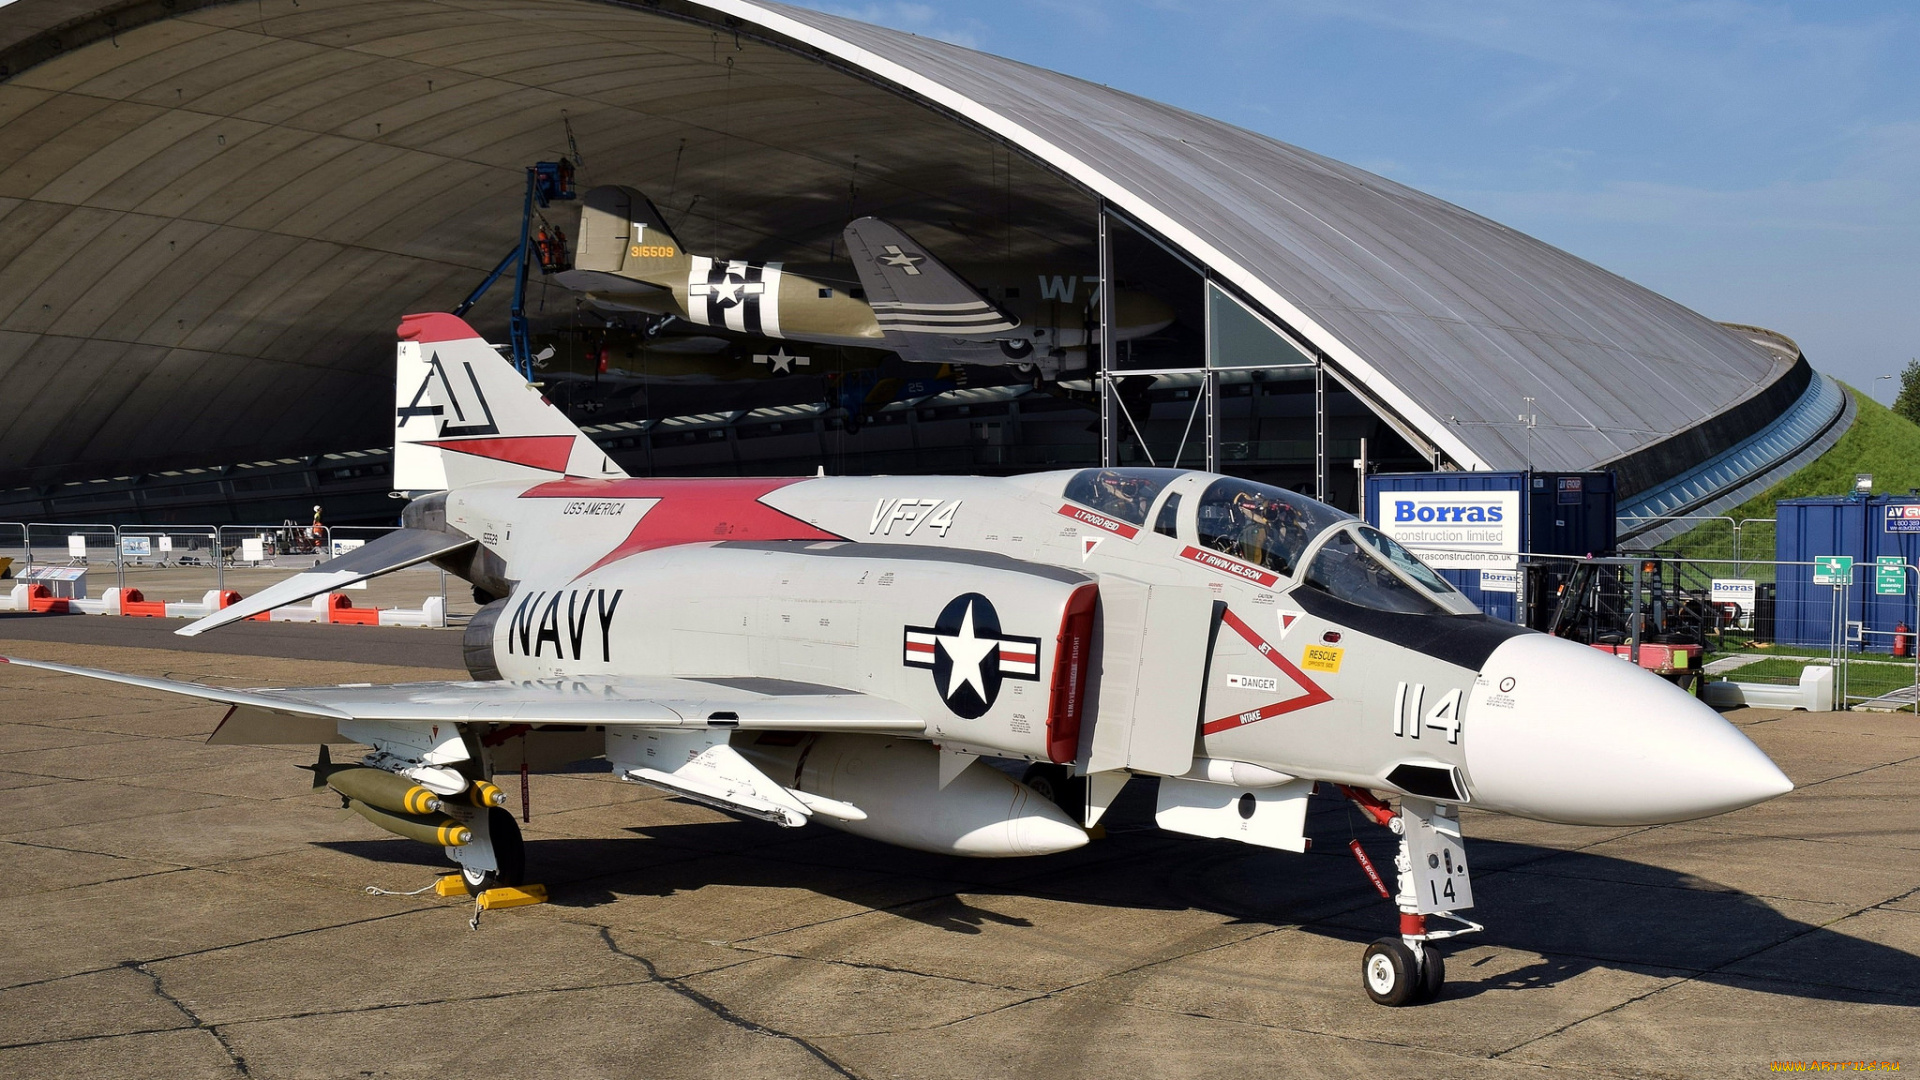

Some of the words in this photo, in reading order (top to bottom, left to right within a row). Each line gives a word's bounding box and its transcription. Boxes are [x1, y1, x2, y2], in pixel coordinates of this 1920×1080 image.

[633, 222, 648, 243] T
[631, 246, 674, 257] 315509
[907, 382, 924, 392] 25
[563, 502, 582, 515] USS
[583, 503, 625, 515] AMERICA
[1395, 501, 1503, 522] Borras
[1888, 507, 1904, 516] AV
[1905, 507, 1920, 517] GR
[869, 498, 962, 537] VF-74
[1084, 511, 1104, 526] POGO
[1395, 530, 1463, 542] construction
[1466, 530, 1503, 542] limited
[1195, 551, 1207, 560] LT
[1206, 555, 1229, 570] IRWIN
[1228, 563, 1262, 580] NELSON
[1714, 583, 1753, 591] Borras
[509, 589, 624, 662] NAVY
[1258, 642, 1272, 655] JET
[1309, 650, 1336, 661] RESCUE
[1241, 677, 1275, 690] DANGER
[1239, 710, 1262, 725] INTAKE
[1393, 681, 1463, 745] 114
[1430, 877, 1456, 906] 14
